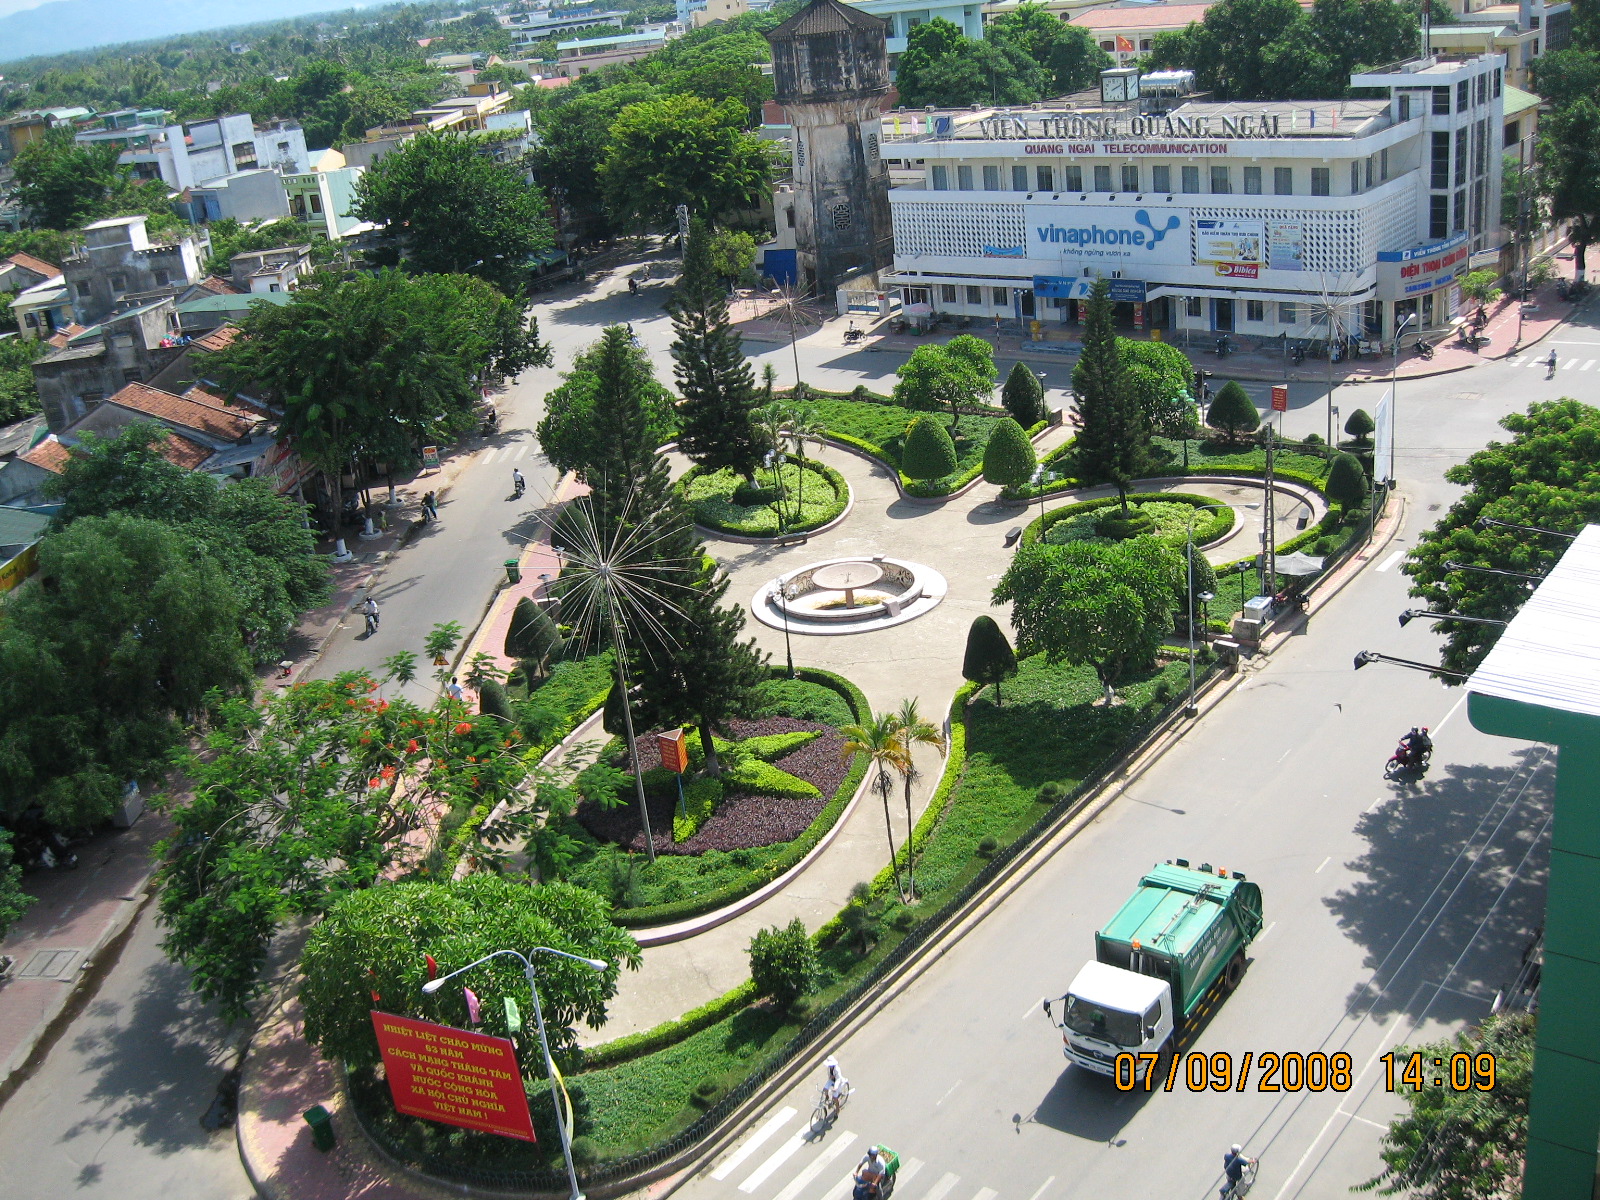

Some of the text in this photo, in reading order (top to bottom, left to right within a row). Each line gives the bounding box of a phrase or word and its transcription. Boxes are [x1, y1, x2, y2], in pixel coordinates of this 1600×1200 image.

[1040, 111, 1117, 138] THÔNG
[1024, 143, 1228, 154] QUANG NGAI TELECOMMUNICATION
[1037, 223, 1145, 247] vinaphone
[1063, 248, 1083, 257] không
[1233, 265, 1257, 275] Bibica
[383, 1023, 413, 1037] NHIỆT
[415, 1030, 437, 1042] LIỆT
[440, 1036, 469, 1049] CHÀO
[425, 1044, 464, 1059] 63 NĂM
[388, 1047, 512, 1080] CÁCH MẠNG THÁNG TÁM
[410, 1063, 494, 1088] VÀ QUỐC KHÁNH
[427, 1088, 445, 1100] HỘI
[444, 1081, 473, 1095] CỘNG
[433, 1101, 456, 1112] VIỆT
[458, 1106, 482, 1118] NAM
